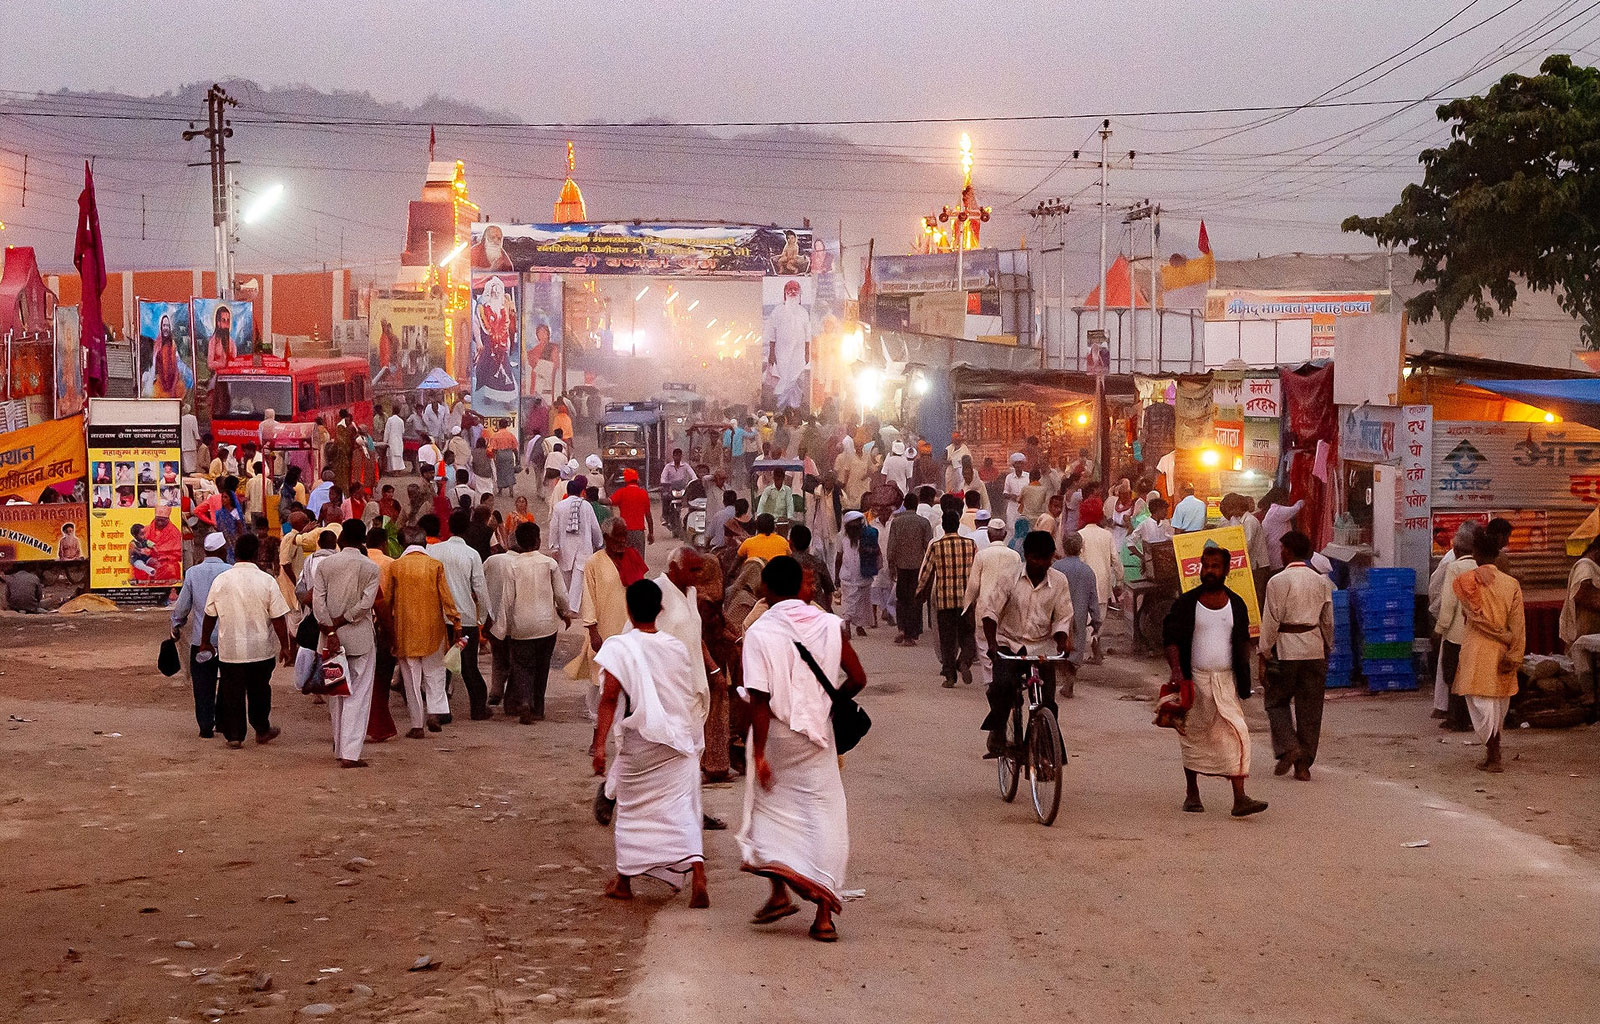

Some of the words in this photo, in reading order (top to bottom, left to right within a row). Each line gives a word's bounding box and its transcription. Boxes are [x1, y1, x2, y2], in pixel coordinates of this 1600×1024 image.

[572, 254, 600, 268] श्री
[1304, 301, 1342, 315] सप्ताह
[1343, 301, 1371, 314] कथा
[1249, 380, 1273, 395] केसरी
[1246, 397, 1278, 415] मरहम
[1408, 420, 1426, 435] दूध
[1215, 427, 1240, 448] उजाला
[1407, 463, 1426, 481] दही
[1405, 489, 1427, 507] पनीर
[8, 530, 52, 556] KATHIABABA
